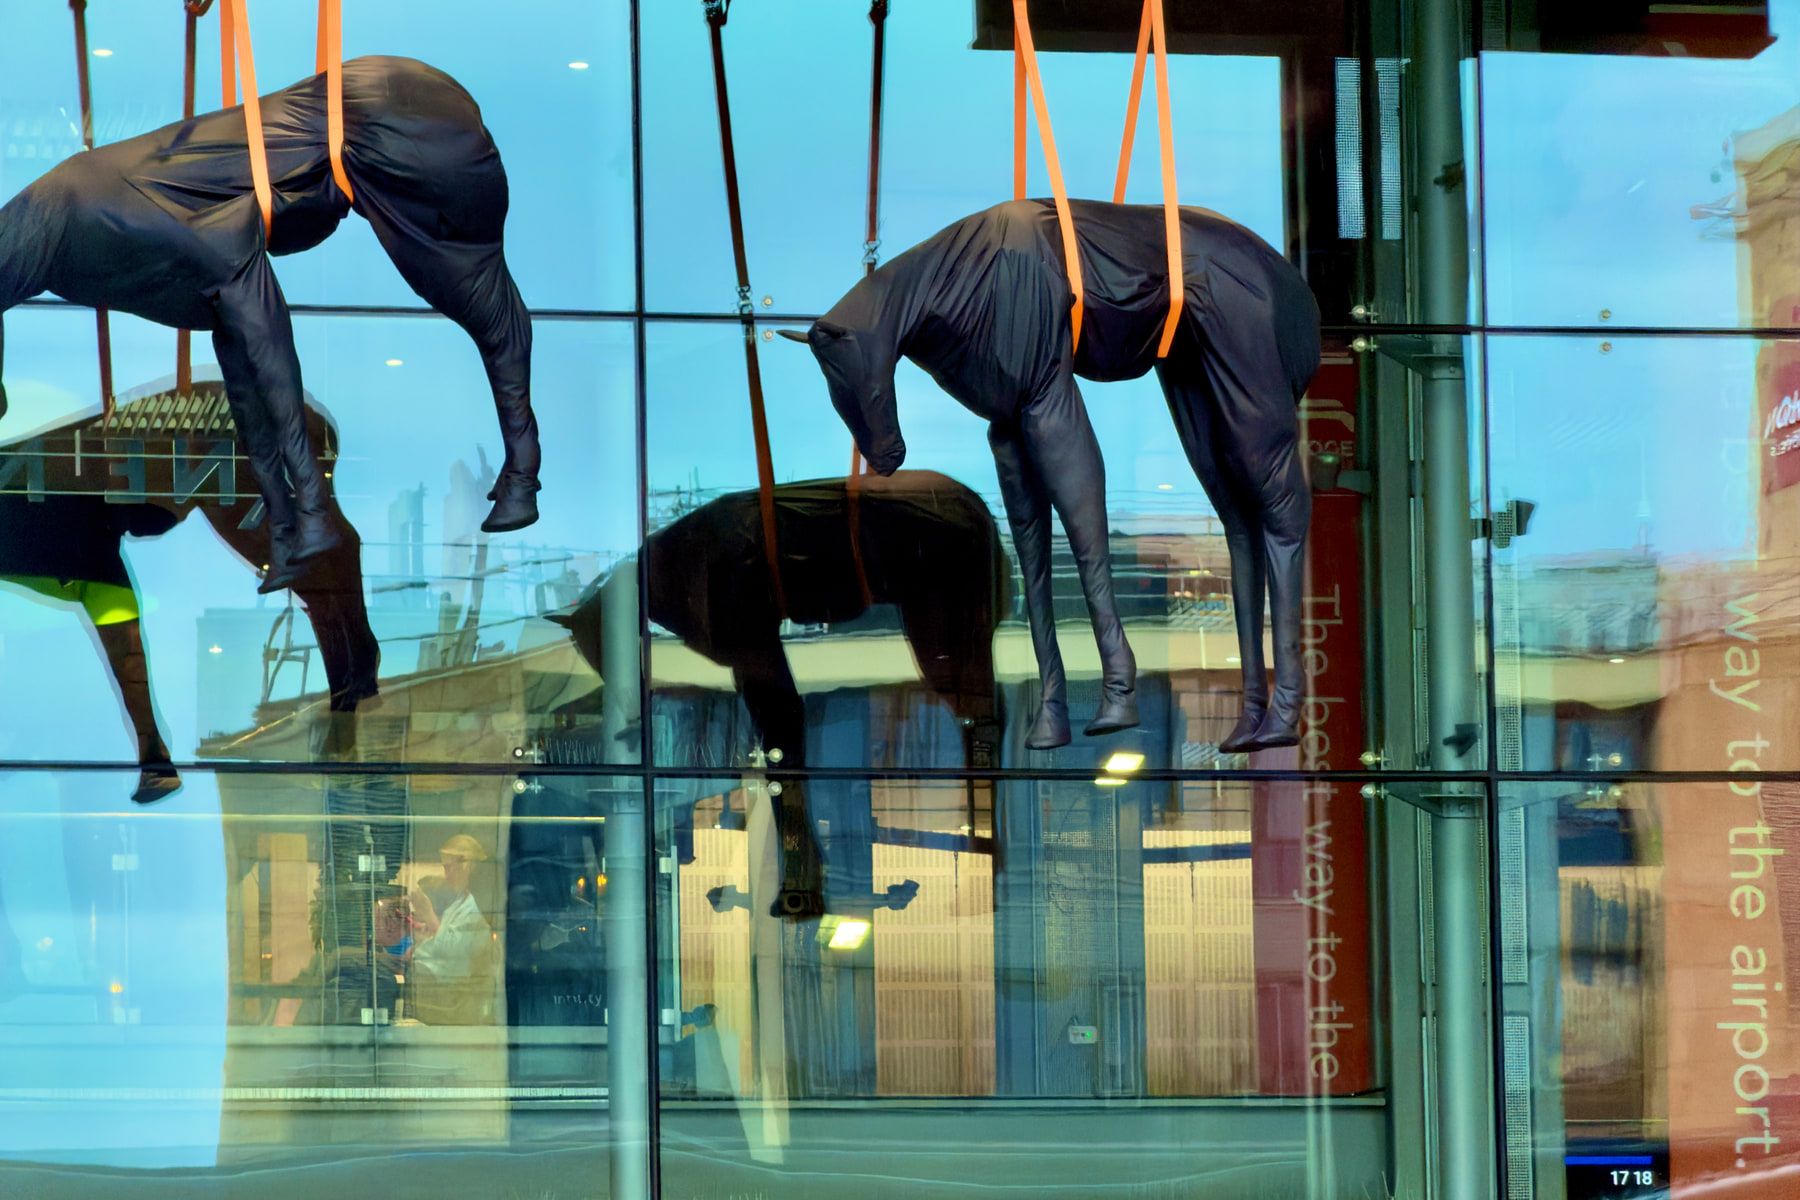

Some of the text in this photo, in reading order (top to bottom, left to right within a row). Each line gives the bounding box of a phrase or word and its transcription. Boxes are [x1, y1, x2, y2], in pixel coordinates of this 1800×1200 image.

[1301, 583, 1343, 677] The
[1709, 592, 1761, 712] way
[1301, 697, 1347, 800] best
[1726, 733, 1770, 797] to
[1293, 820, 1335, 915] way
[1727, 820, 1785, 919] the
[1306, 932, 1342, 982] to
[1309, 1000, 1354, 1081] the
[1716, 944, 1783, 1168] airport.
[1610, 1170, 1653, 1186] 17 18
